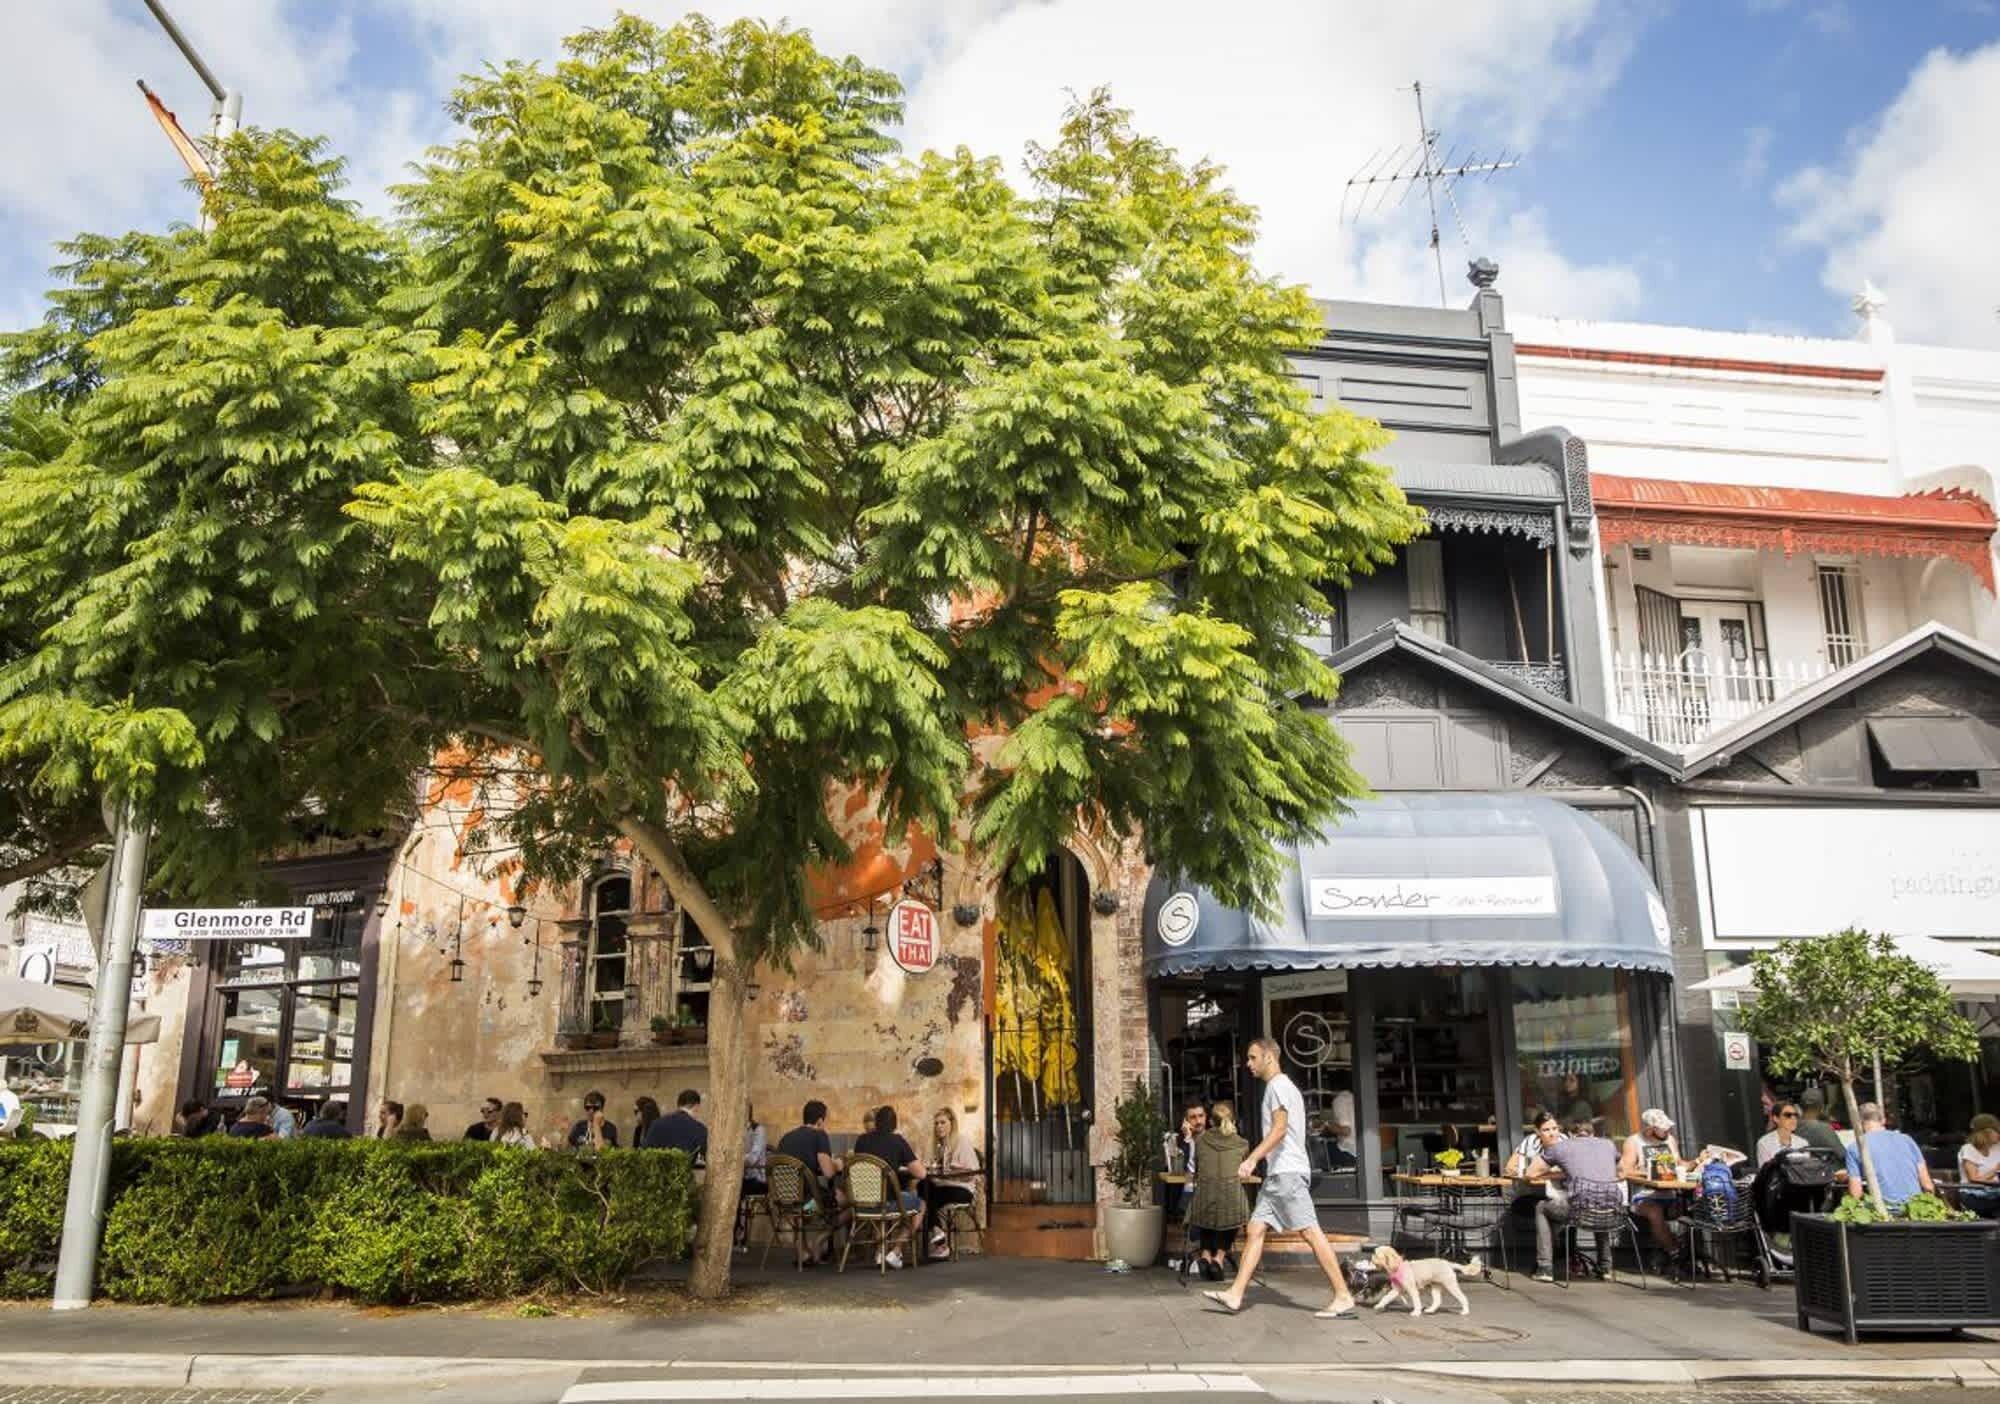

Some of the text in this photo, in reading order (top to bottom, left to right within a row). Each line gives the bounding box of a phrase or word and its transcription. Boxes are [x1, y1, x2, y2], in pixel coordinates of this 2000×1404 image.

[1320, 884, 1440, 909] Sonder
[1888, 870, 2000, 900] padding
[174, 911, 273, 928] Glenmore
[280, 910, 306, 927] Rd
[900, 909, 929, 939] EAT
[1166, 906, 1192, 932] S
[900, 943, 931, 963] THAI
[1292, 1025, 1326, 1056] S
